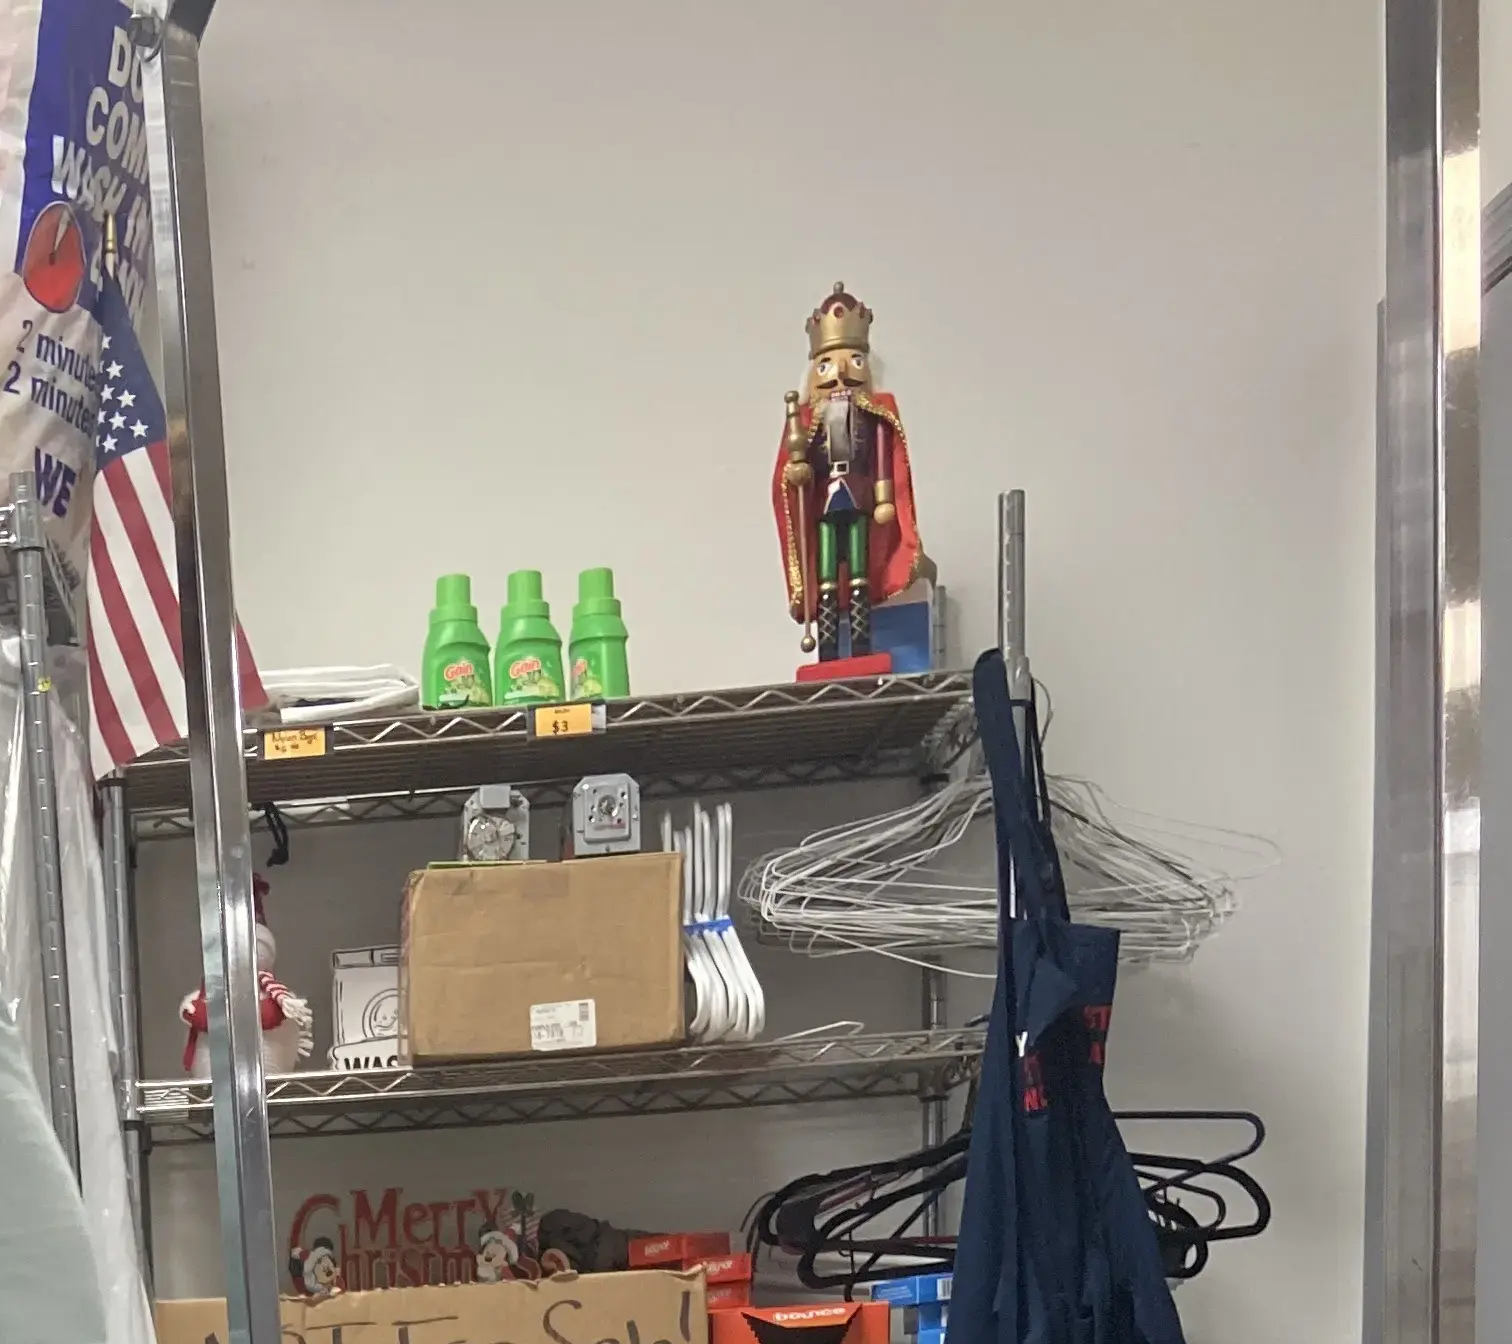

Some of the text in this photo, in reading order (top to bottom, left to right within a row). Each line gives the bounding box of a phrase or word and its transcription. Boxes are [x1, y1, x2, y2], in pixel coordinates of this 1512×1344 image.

[3, 360, 21, 395] 2
[36, 333, 97, 396] minute
[35, 447, 76, 518] WE
[350, 1187, 510, 1251] Merry
